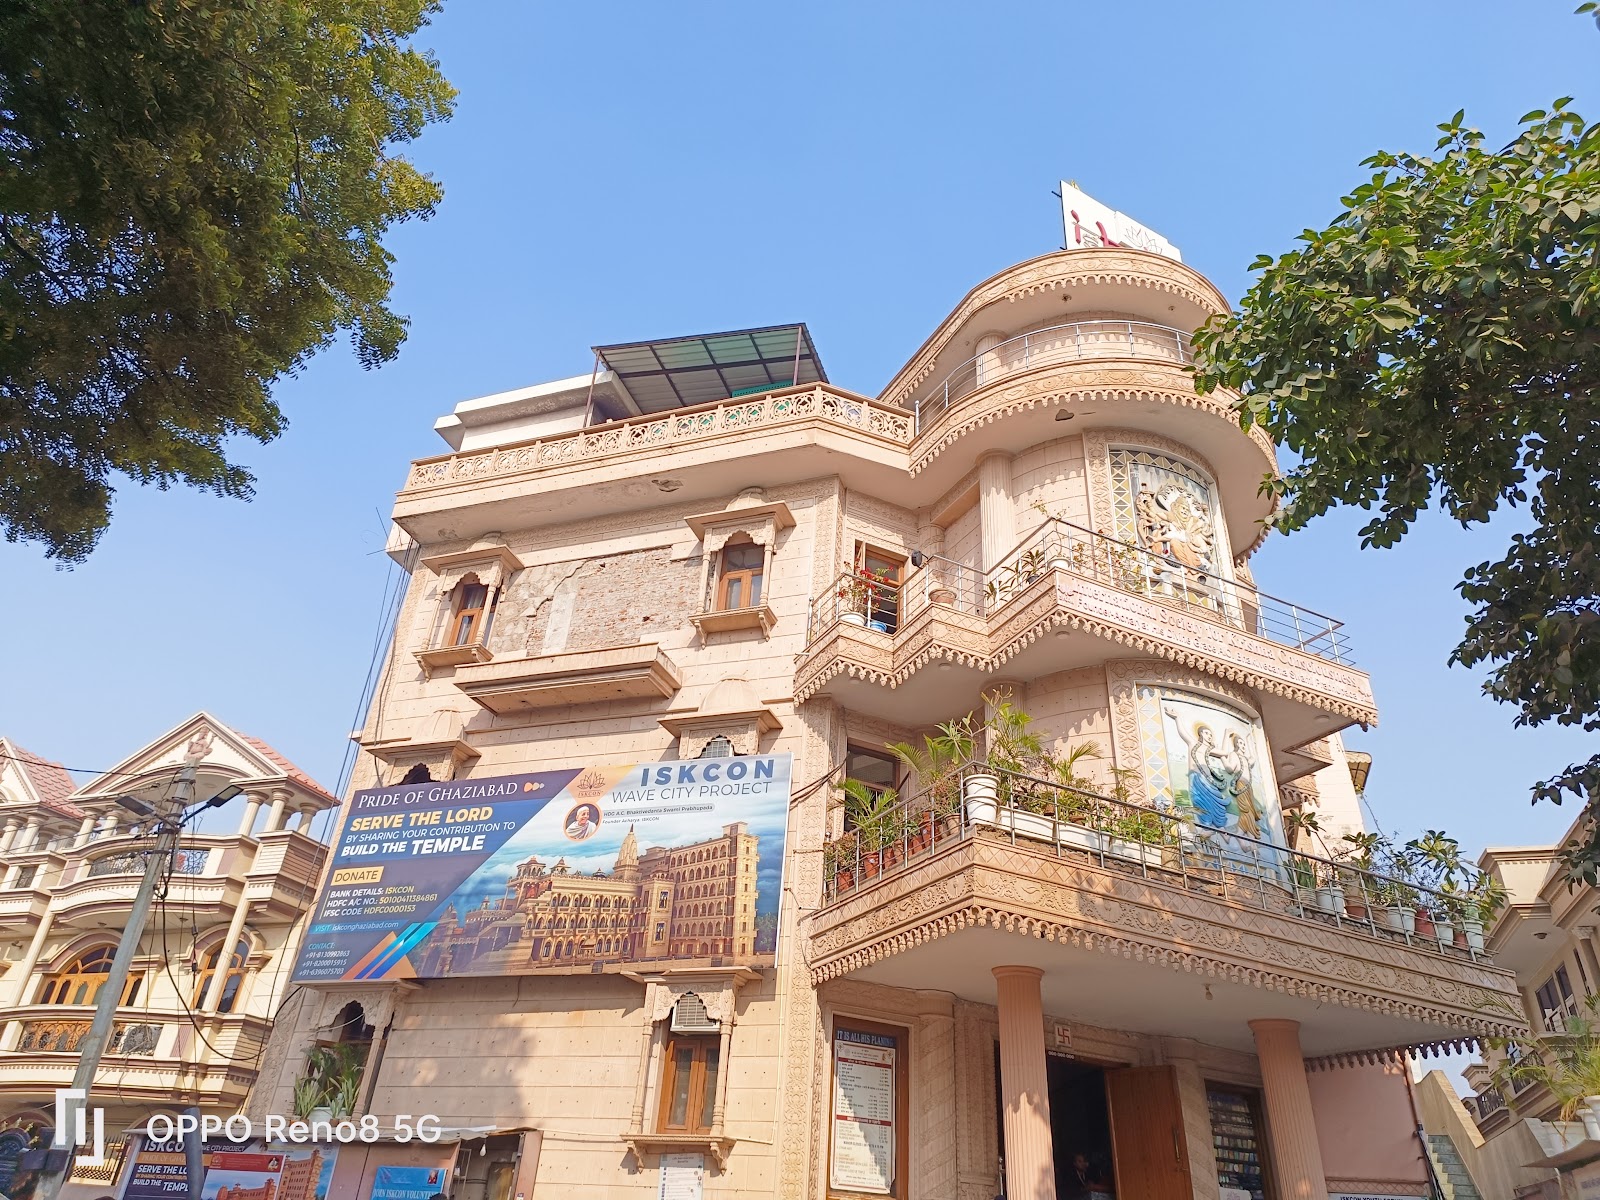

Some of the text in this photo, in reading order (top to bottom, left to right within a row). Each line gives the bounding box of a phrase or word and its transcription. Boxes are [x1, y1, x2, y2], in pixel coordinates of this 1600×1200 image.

[1160, 608, 1204, 639] Society
[1206, 626, 1224, 644] for
[1226, 631, 1276, 661] Krishna
[1278, 650, 1357, 688] Consciousness
[1167, 629, 1191, 646] Divine
[1193, 638, 1217, 654] Grace
[1289, 669, 1314, 686] Swami
[641, 759, 774, 787] ISKCON
[404, 790, 425, 804] OF
[428, 782, 518, 801] GHAZIABAD
[577, 790, 601, 798] ISKCON
[612, 781, 772, 804] WAVE CITY PROJECT
[681, 804, 713, 813] Prabhupada
[350, 806, 493, 832] SERVE THE LORD
[346, 821, 516, 844] BY SHARING YOUR CONTRIBUTION TO
[341, 834, 486, 857] BUILD THE TEMPLE
[334, 869, 379, 883] DONATE
[330, 886, 414, 898] BANK DETAILS: ISKCON
[327, 899, 347, 908] HDFC
[348, 898, 361, 907] A/C
[323, 904, 416, 918] IFSC CODE HDFC0000153
[332, 921, 399, 932] iskconghaziabad.com
[308, 942, 336, 950] CONTACT:
[850, 1032, 860, 1043] ALL
[860, 1033, 871, 1044] HIS
[144, 1139, 185, 1153] ISKCO
[222, 1145, 245, 1153] PROJECT
[137, 1164, 161, 1174] SERVE
[162, 1165, 178, 1175] THE
[133, 1178, 189, 1192] BUILD THE TEMPL
[372, 1188, 439, 1200] JOIN ISKCON VOLUNTE
